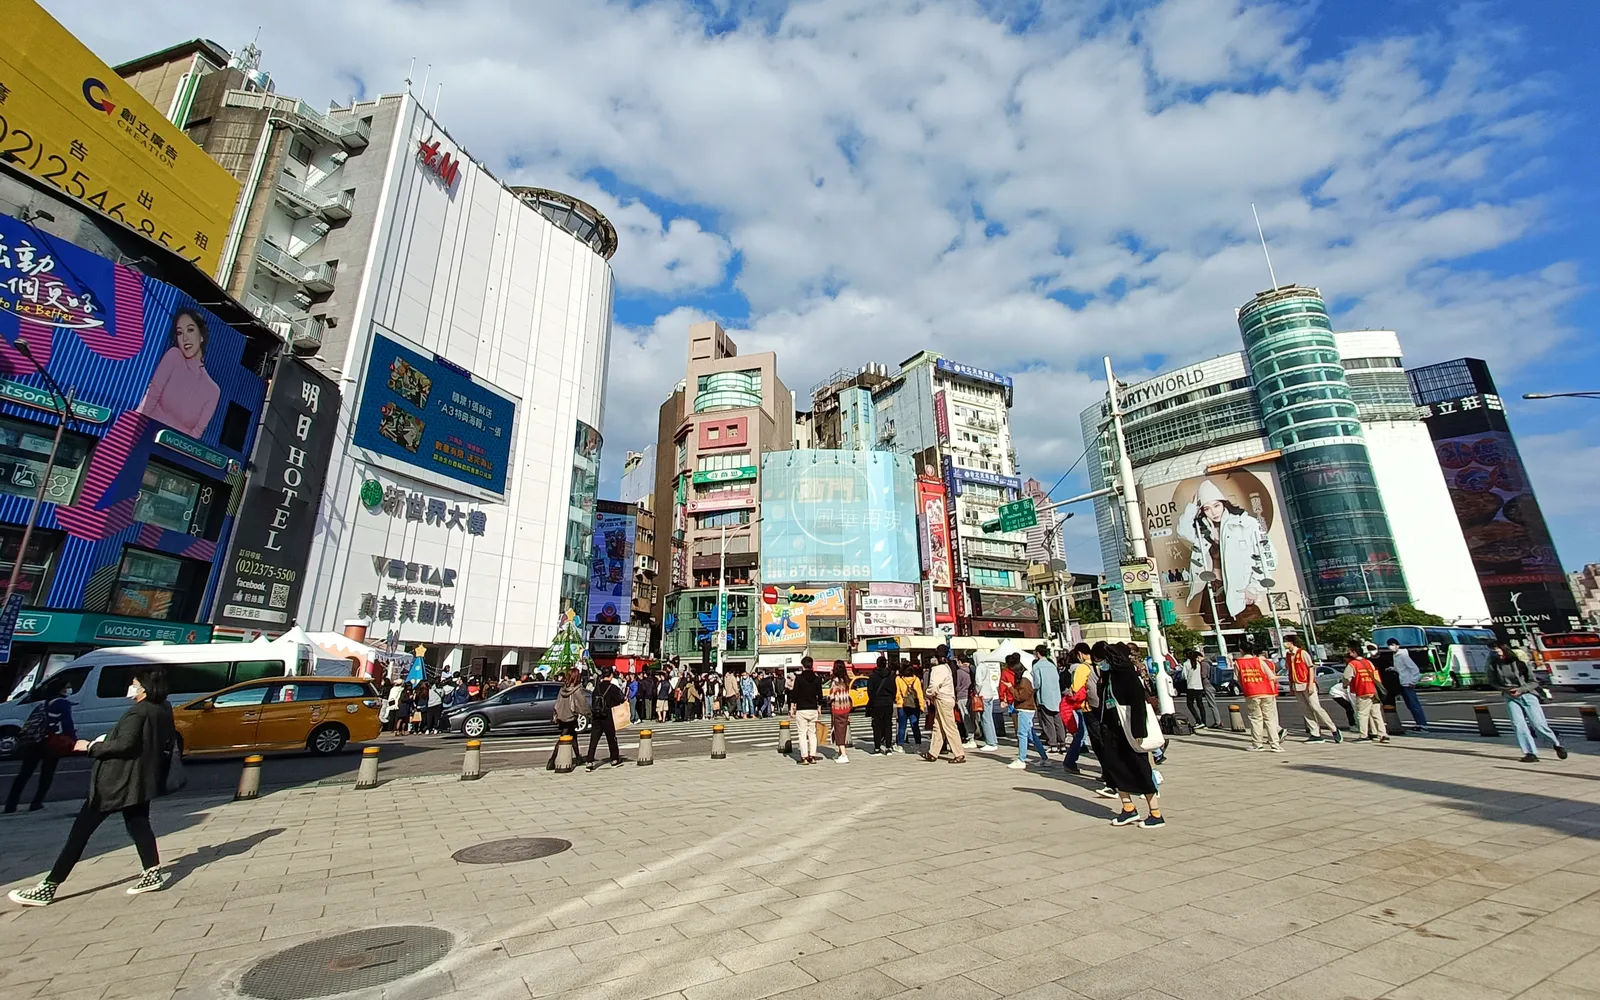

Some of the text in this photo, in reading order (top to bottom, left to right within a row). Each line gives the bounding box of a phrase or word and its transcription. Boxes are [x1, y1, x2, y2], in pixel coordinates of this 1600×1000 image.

[120, 107, 179, 162] 創立廣告
[117, 119, 175, 170] CREATION
[15, 300, 31, 313] be
[35, 304, 76, 321] Better
[264, 380, 321, 552] 明日 HOTEL
[1146, 500, 1178, 517] AJOR
[1148, 515, 1173, 531] ADE
[235, 557, 297, 584] (02)2375-5500
[236, 577, 266, 592] facebook
[1490, 613, 1551, 625] MIDTOWN
[104, 625, 151, 637] watsons
